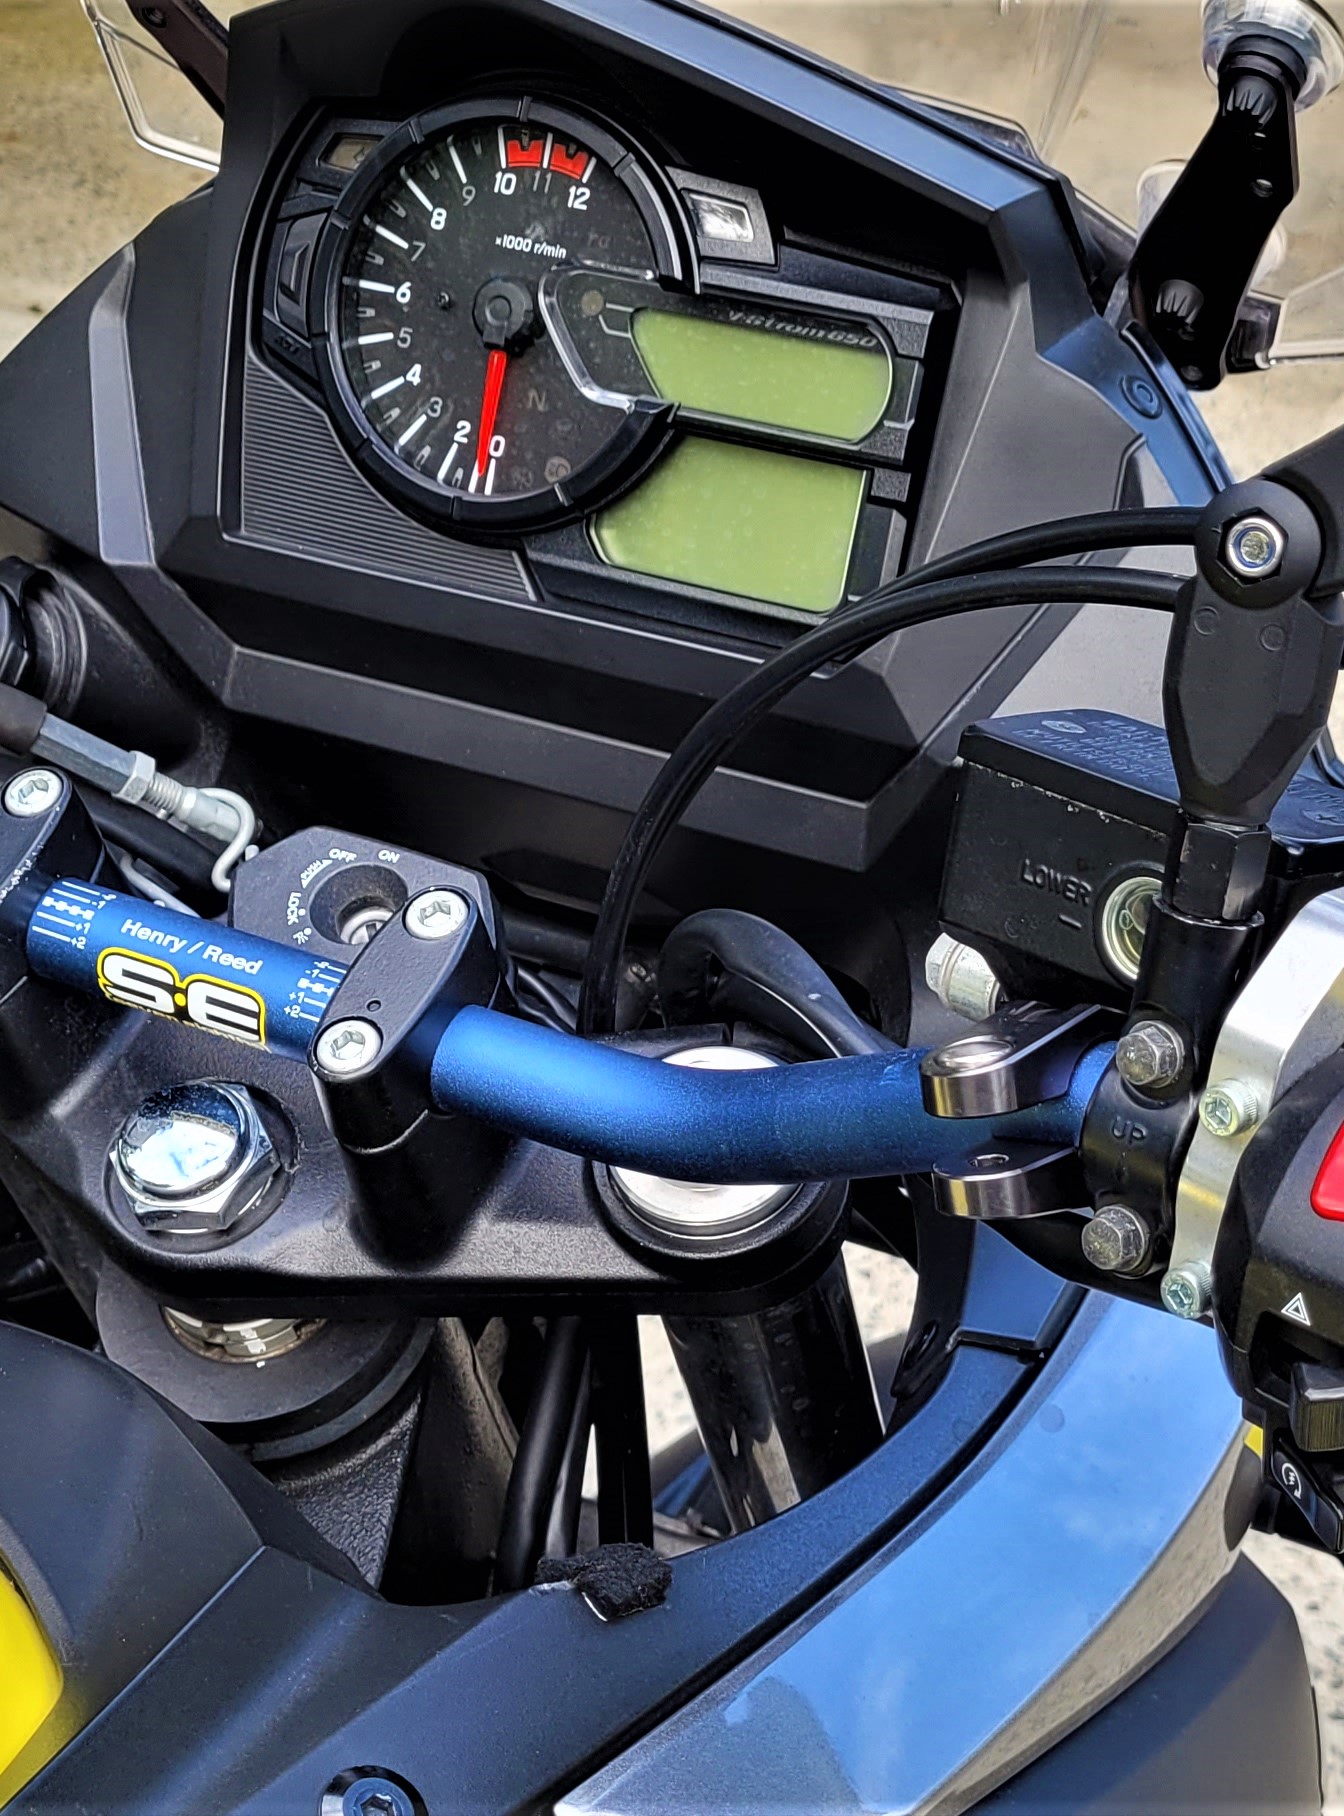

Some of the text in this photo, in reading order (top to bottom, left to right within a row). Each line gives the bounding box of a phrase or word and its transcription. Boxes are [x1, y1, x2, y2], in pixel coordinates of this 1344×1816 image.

[493, 170, 517, 195] 10
[533, 170, 552, 194] 11
[462, 185, 476, 206] 9
[567, 185, 591, 211] 12
[430, 207, 447, 231] 8
[411, 240, 426, 262] 7
[533, 240, 567, 259] r/min
[396, 281, 412, 304] 6
[397, 327, 413, 348] 5
[406, 363, 422, 386] 4
[427, 396, 443, 418] 3
[528, 389, 548, 412] N
[454, 420, 471, 444] 2
[489, 435, 505, 457] 0
[328, 848, 357, 863] OFF
[378, 849, 400, 863] ON
[1021, 858, 1092, 906] LOWER
[287, 892, 302, 925] LOCK
[120, 918, 263, 975] Henry / Reed
[1111, 1115, 1147, 1146] UP
